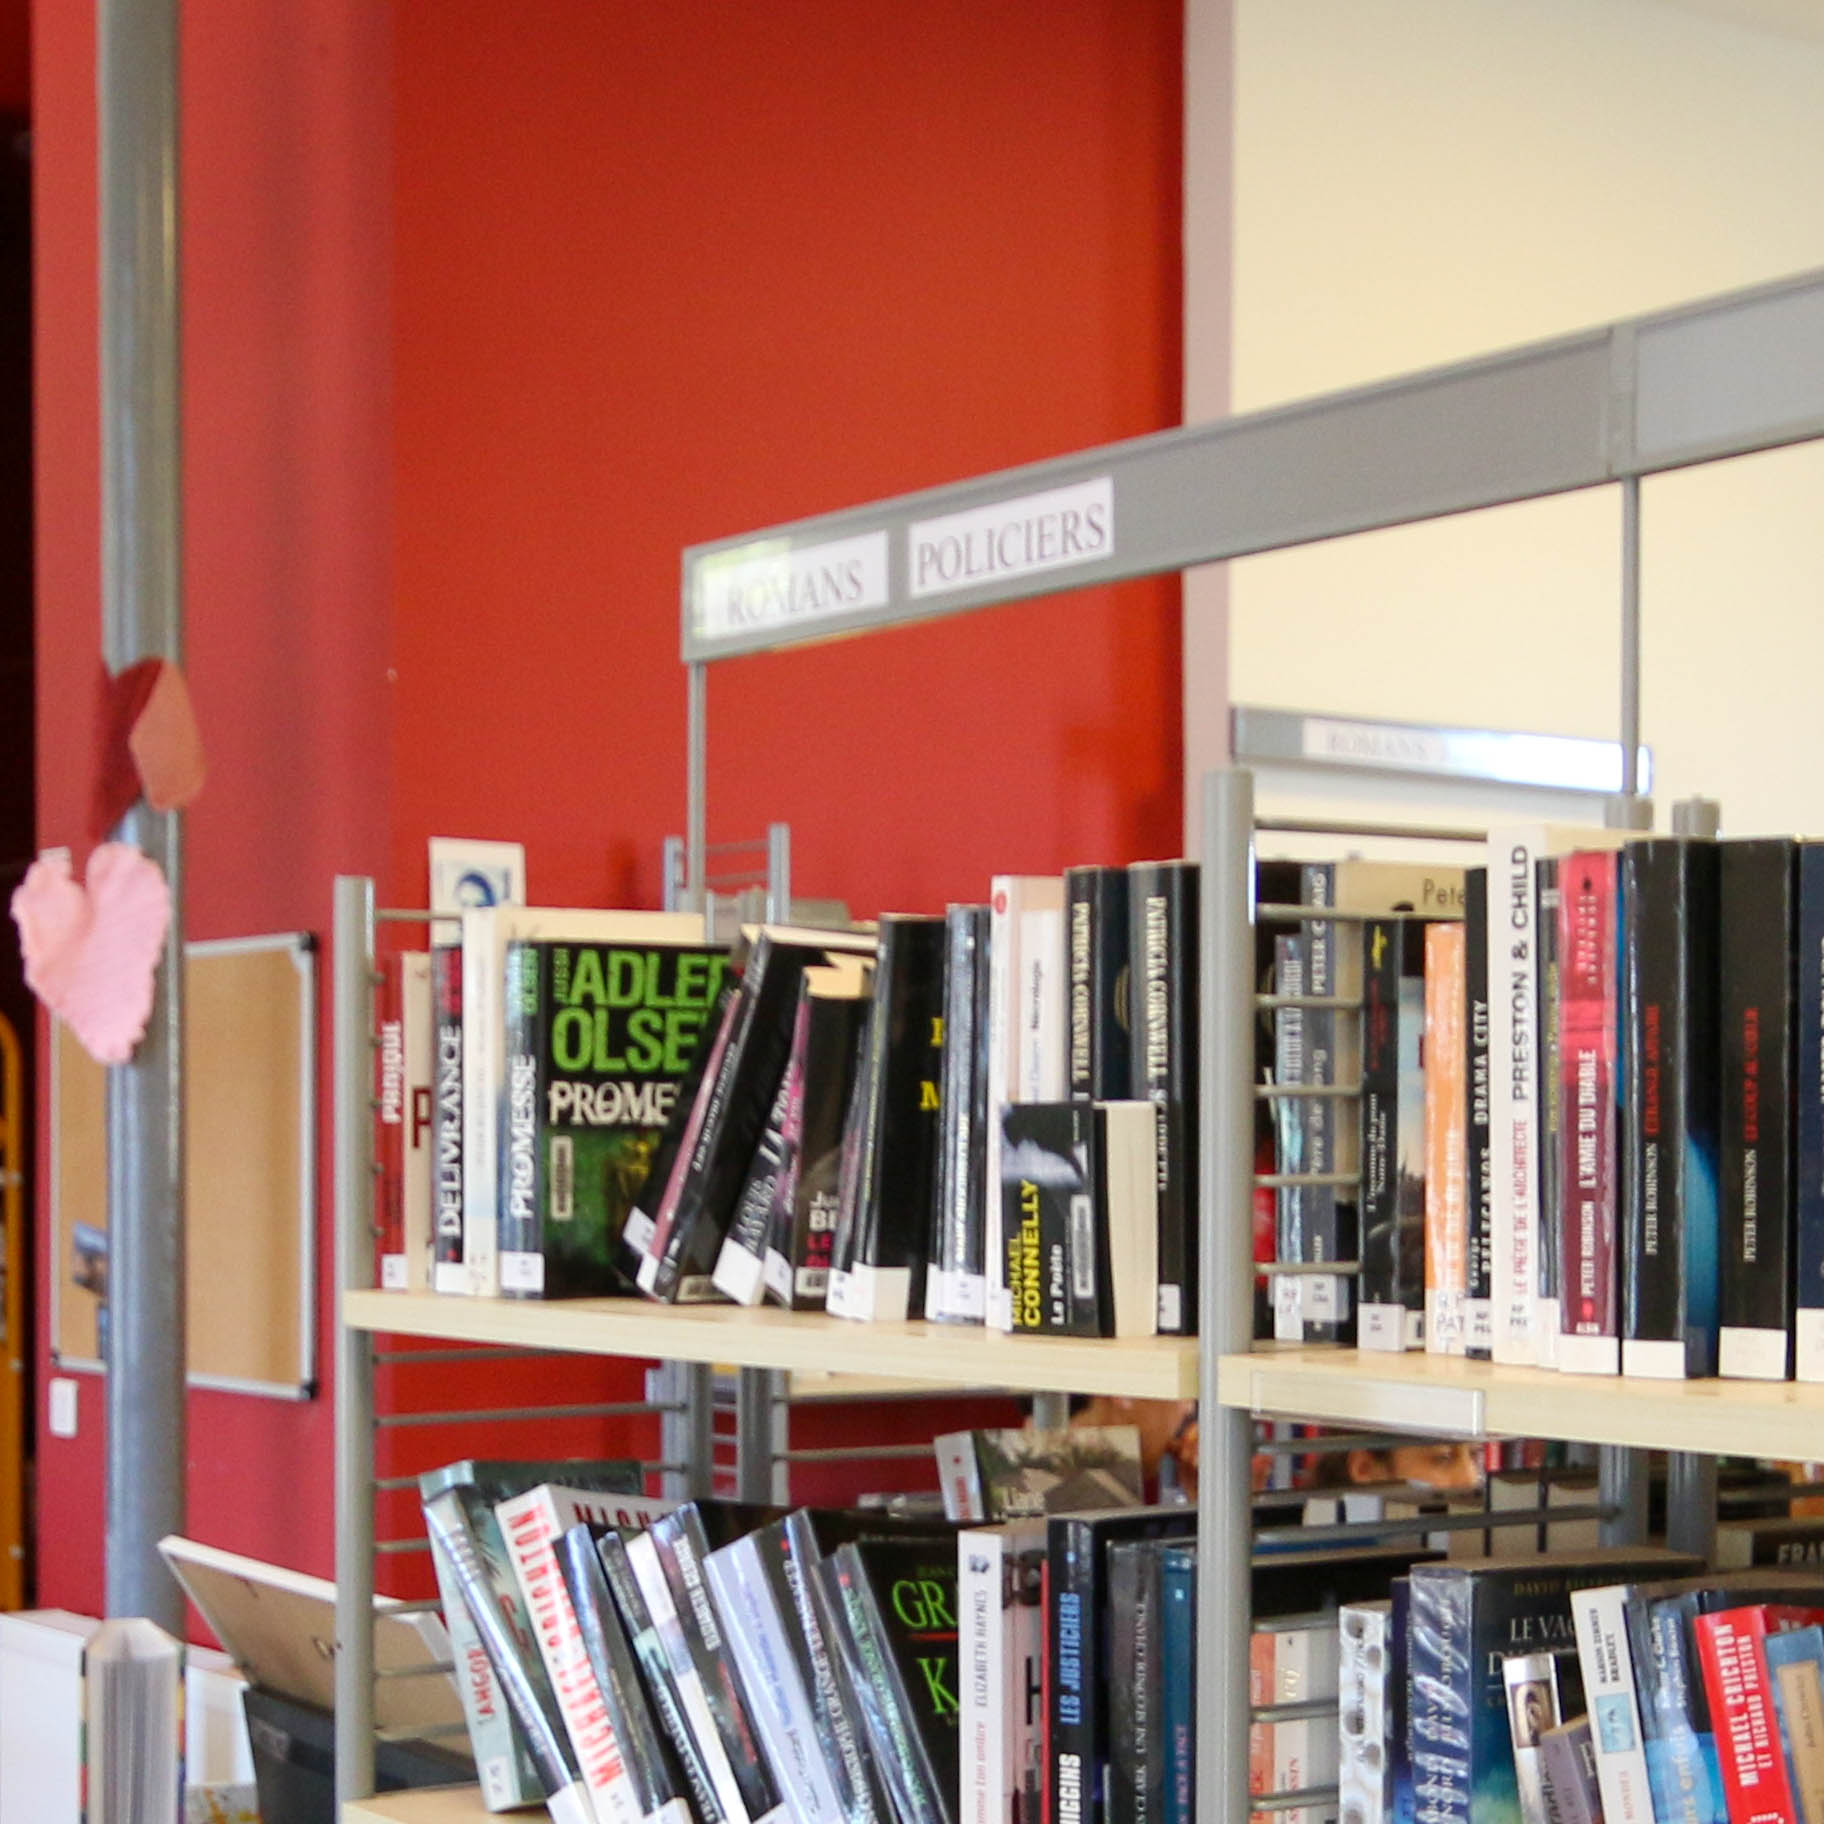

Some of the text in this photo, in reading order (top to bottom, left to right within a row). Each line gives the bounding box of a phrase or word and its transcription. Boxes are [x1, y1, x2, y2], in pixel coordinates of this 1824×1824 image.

[727, 560, 863, 624] ROMANS
[918, 504, 1105, 585] POLICIERS
[1511, 845, 1530, 1099] PRESTON & CHILD
[551, 1009, 707, 1073] OLSE
[1474, 1001, 1487, 1124] DRAMA CITY
[511, 1054, 536, 1219] PROMESSE
[1579, 1048, 1597, 1189] L'AMIE DU DIABLE
[1645, 1141, 1659, 1255] PETER ROBINSON
[1743, 1148, 1758, 1262] PETER ROBINSON
[1010, 1232, 1023, 1326] MICHAEL
[1024, 1179, 1039, 1328] CONNELLY
[1051, 1305, 1063, 1326] Le
[975, 1641, 989, 1709] ELIZABETH
[1060, 1592, 1081, 1689] JUSTICIERS
[1608, 1633, 1619, 1684] BRADLEY
[1738, 1636, 1770, 1748] RICHARD PRESTON
[1060, 1693, 1081, 1725] LES
[1710, 1623, 1760, 1787] MICHAEL CRICHTON
